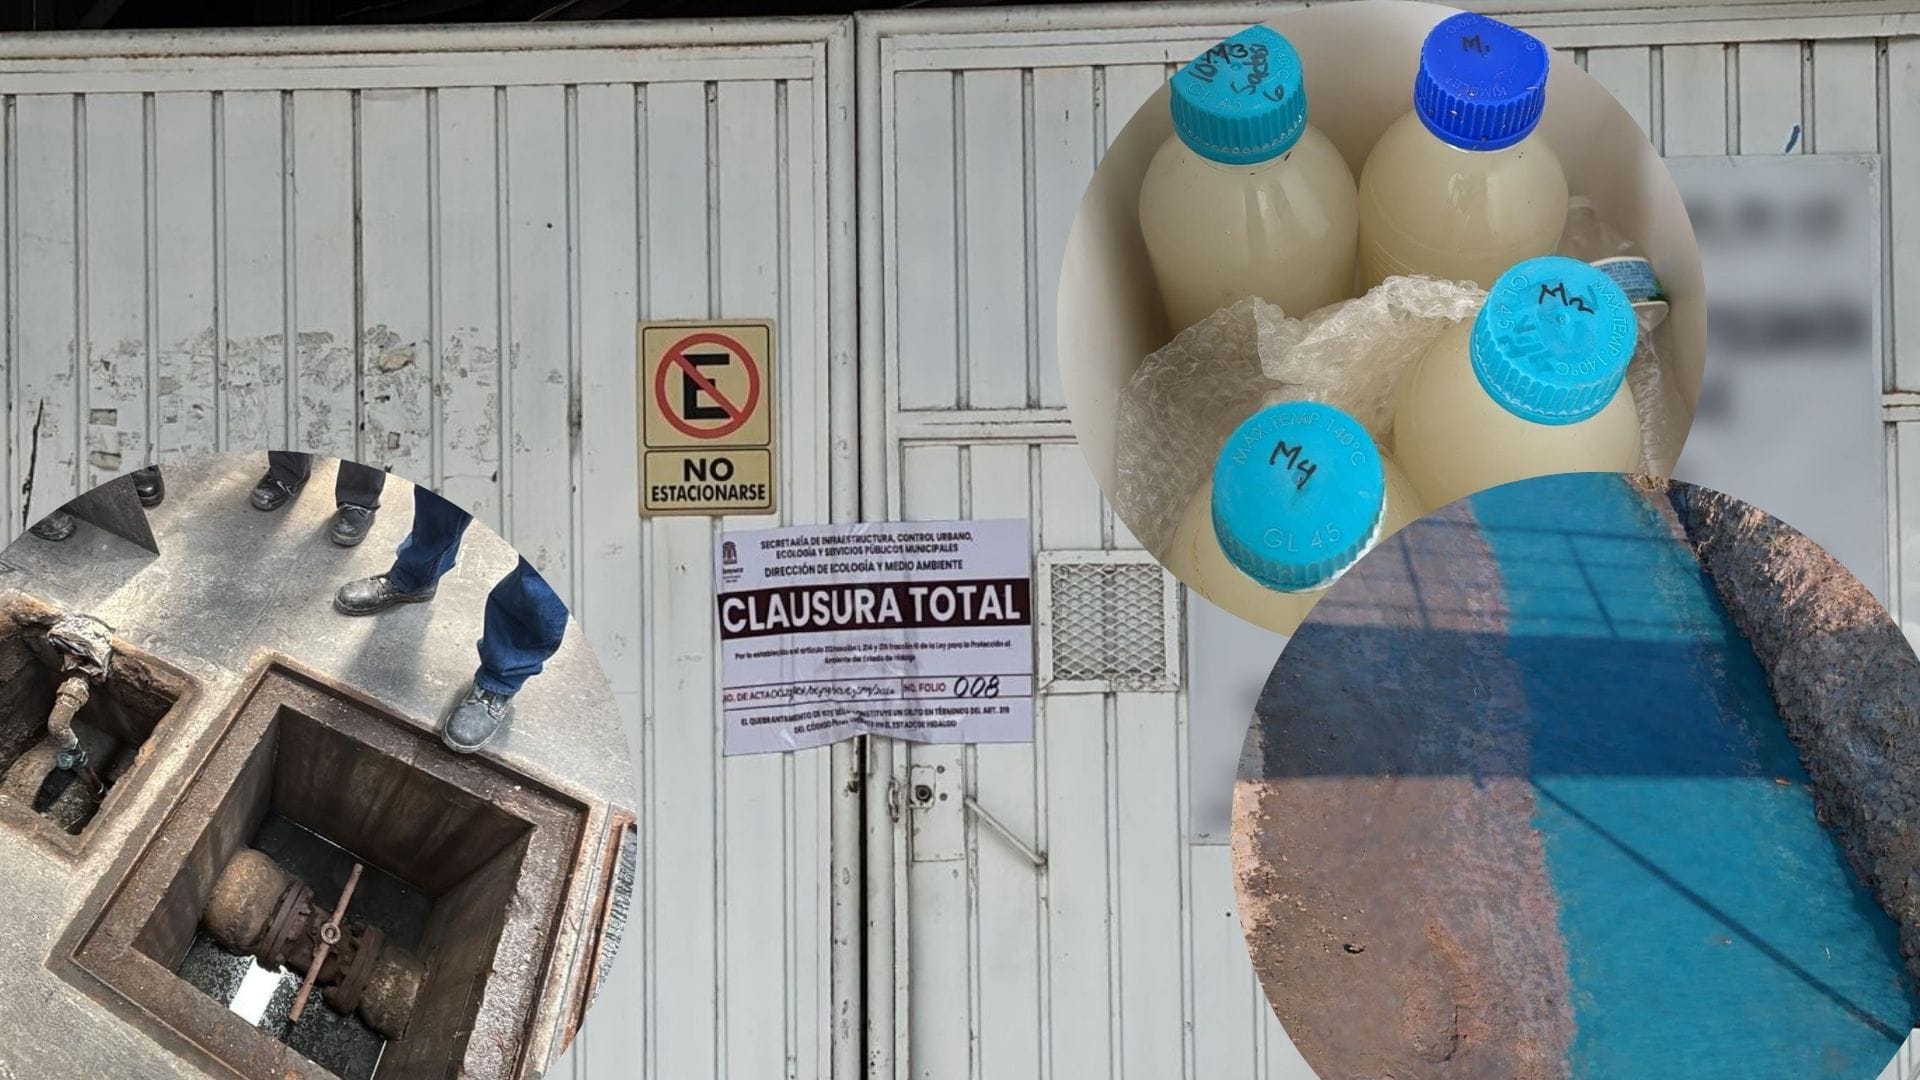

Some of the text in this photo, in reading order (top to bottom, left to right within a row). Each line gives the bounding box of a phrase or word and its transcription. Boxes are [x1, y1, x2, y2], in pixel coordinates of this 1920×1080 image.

[683, 457, 735, 482] NO
[651, 483, 766, 502] ESTACIONARSE
[760, 535, 808, 550] SECRETARÍA
[810, 536, 819, 546] DE
[897, 532, 935, 543] CONTROL
[936, 531, 973, 543] URBANO,
[776, 547, 816, 559] ECOLOGÍA
[825, 546, 863, 557] SERVICIOS
[865, 543, 904, 555] PÚBLICOS
[905, 543, 959, 553] MUNICIPALES
[765, 558, 963, 578] DIRECCIÓN DE ECOLOGÍA Y MEDIO AMBIENTE
[723, 583, 1021, 633] CLAUSURA TOTAL
[737, 692, 747, 701] DE
[749, 690, 771, 700] ACTA
[918, 682, 946, 692] FOLIO
[954, 675, 1000, 698] 008
